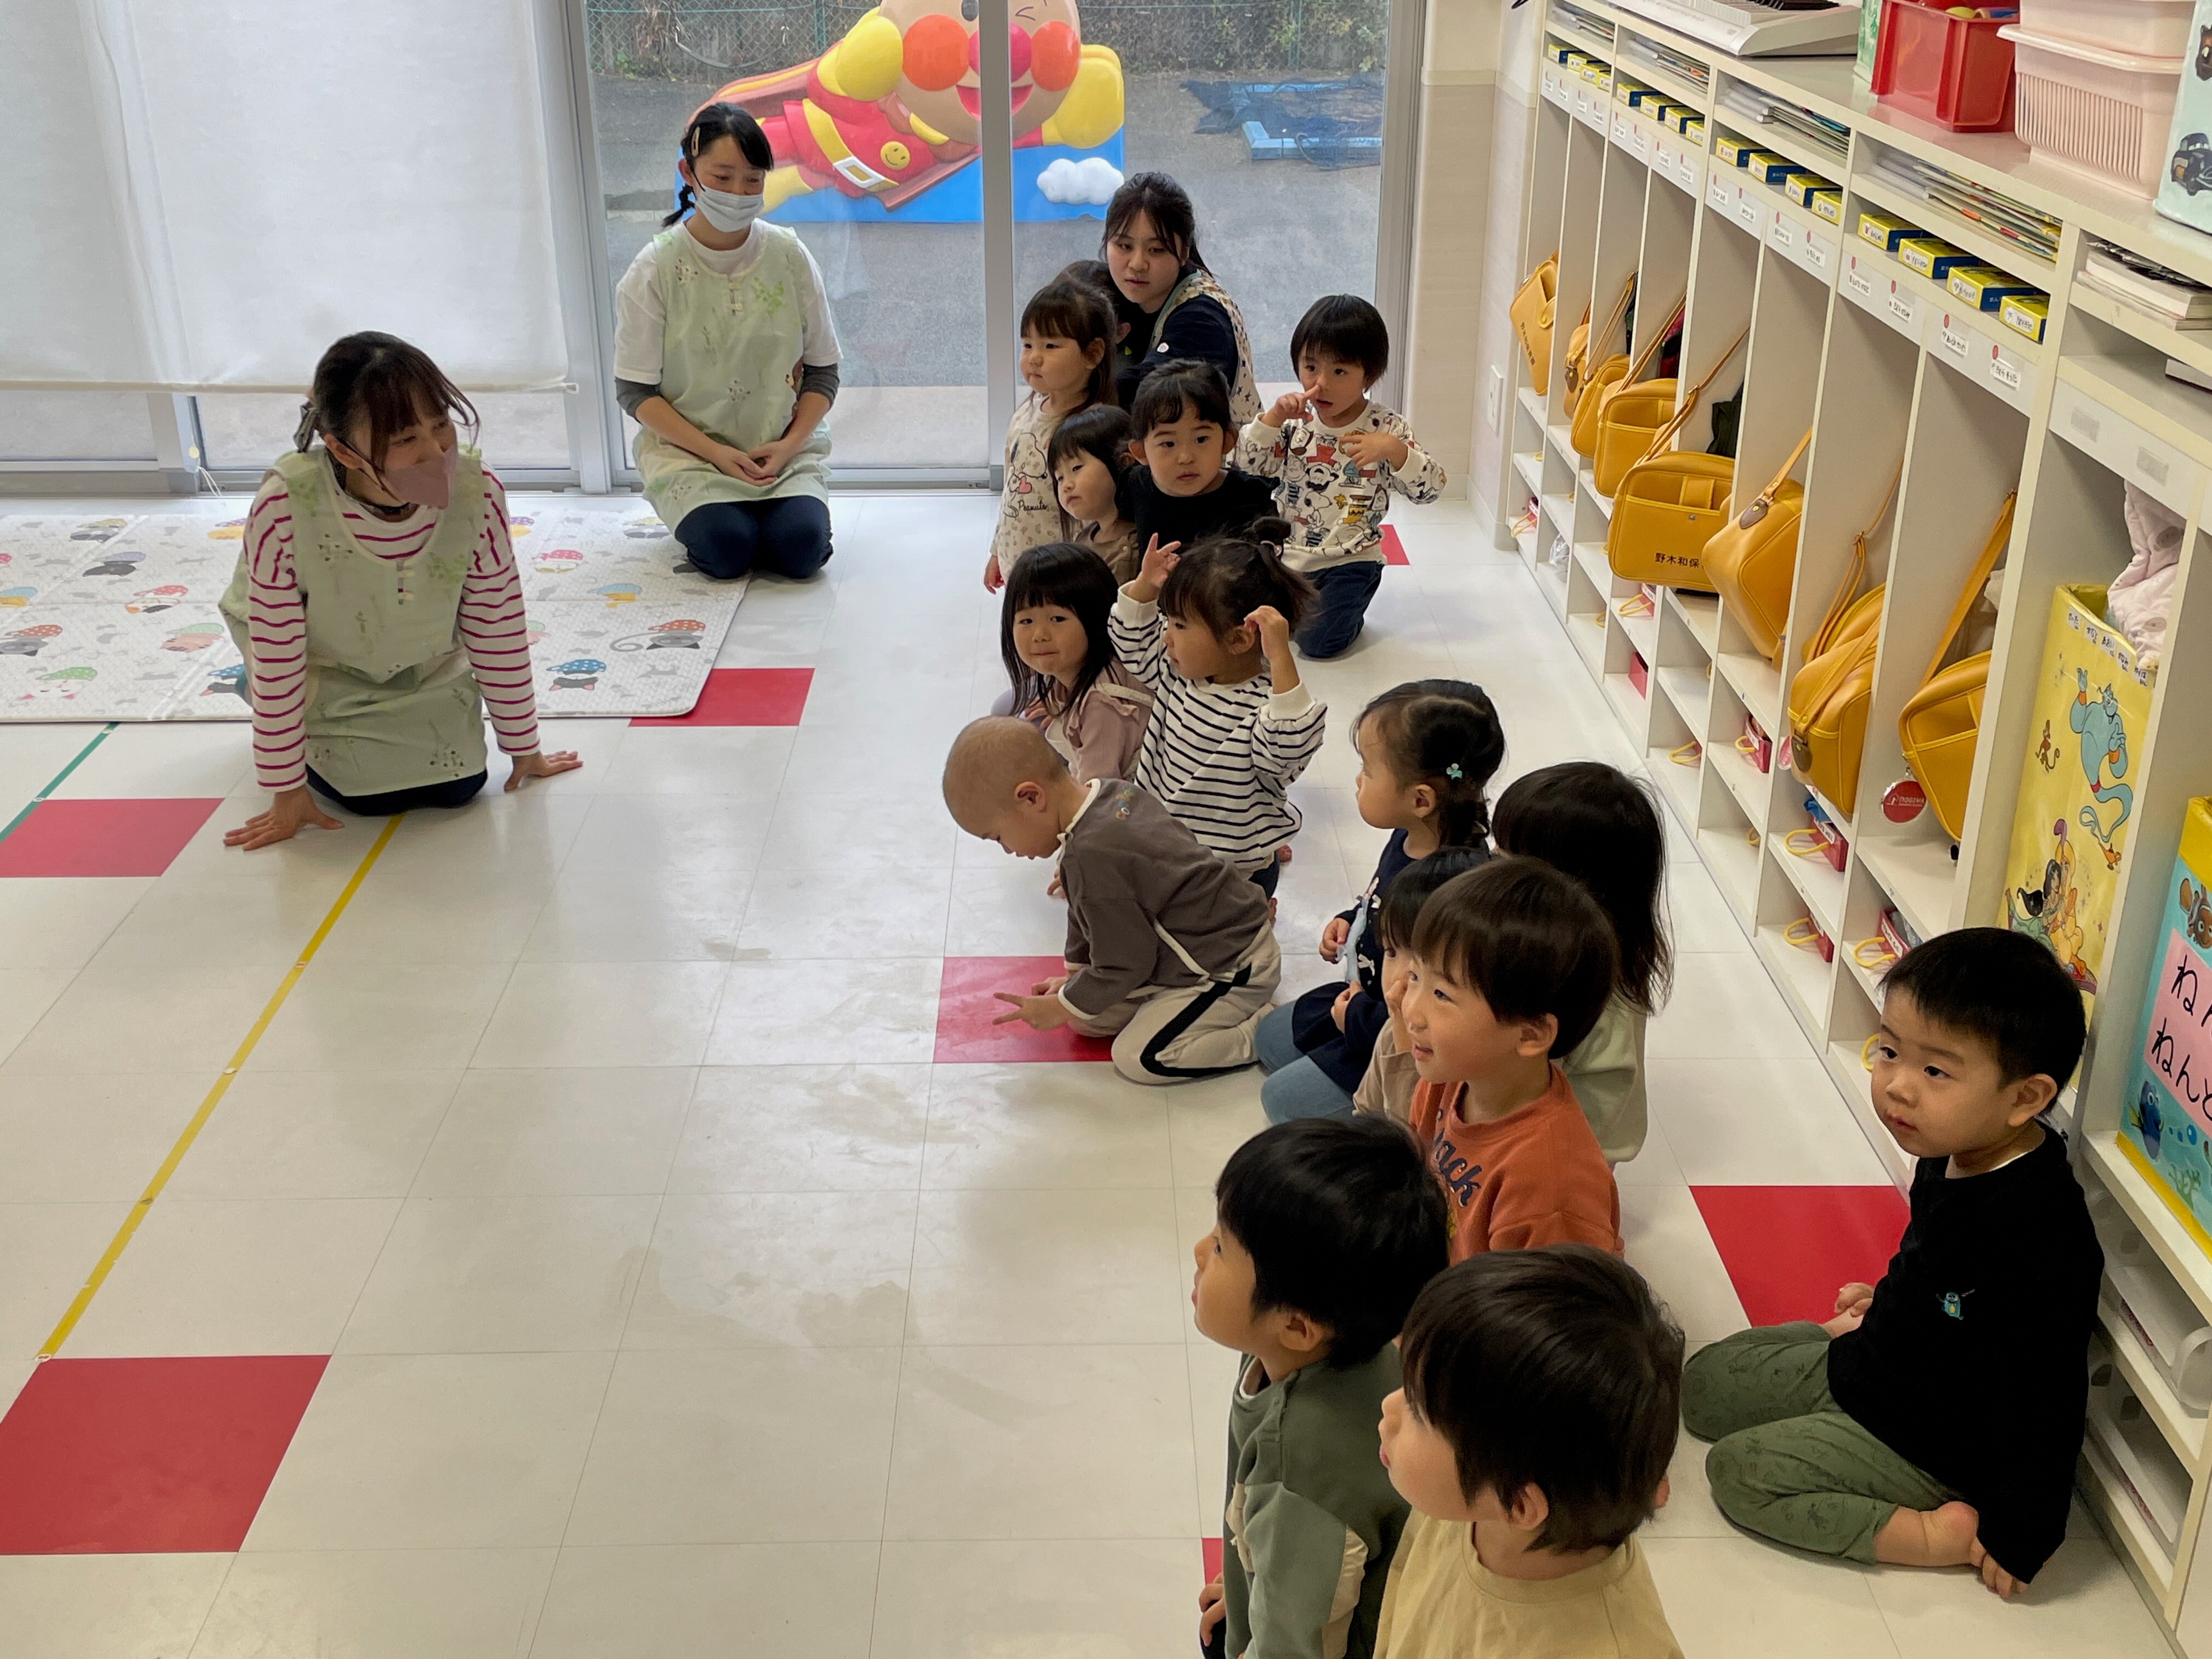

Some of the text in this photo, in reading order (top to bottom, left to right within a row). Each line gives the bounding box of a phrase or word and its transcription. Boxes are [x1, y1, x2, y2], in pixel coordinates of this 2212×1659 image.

[1655, 552, 1704, 571] 野木和保
[2171, 954, 2212, 1028] ね
